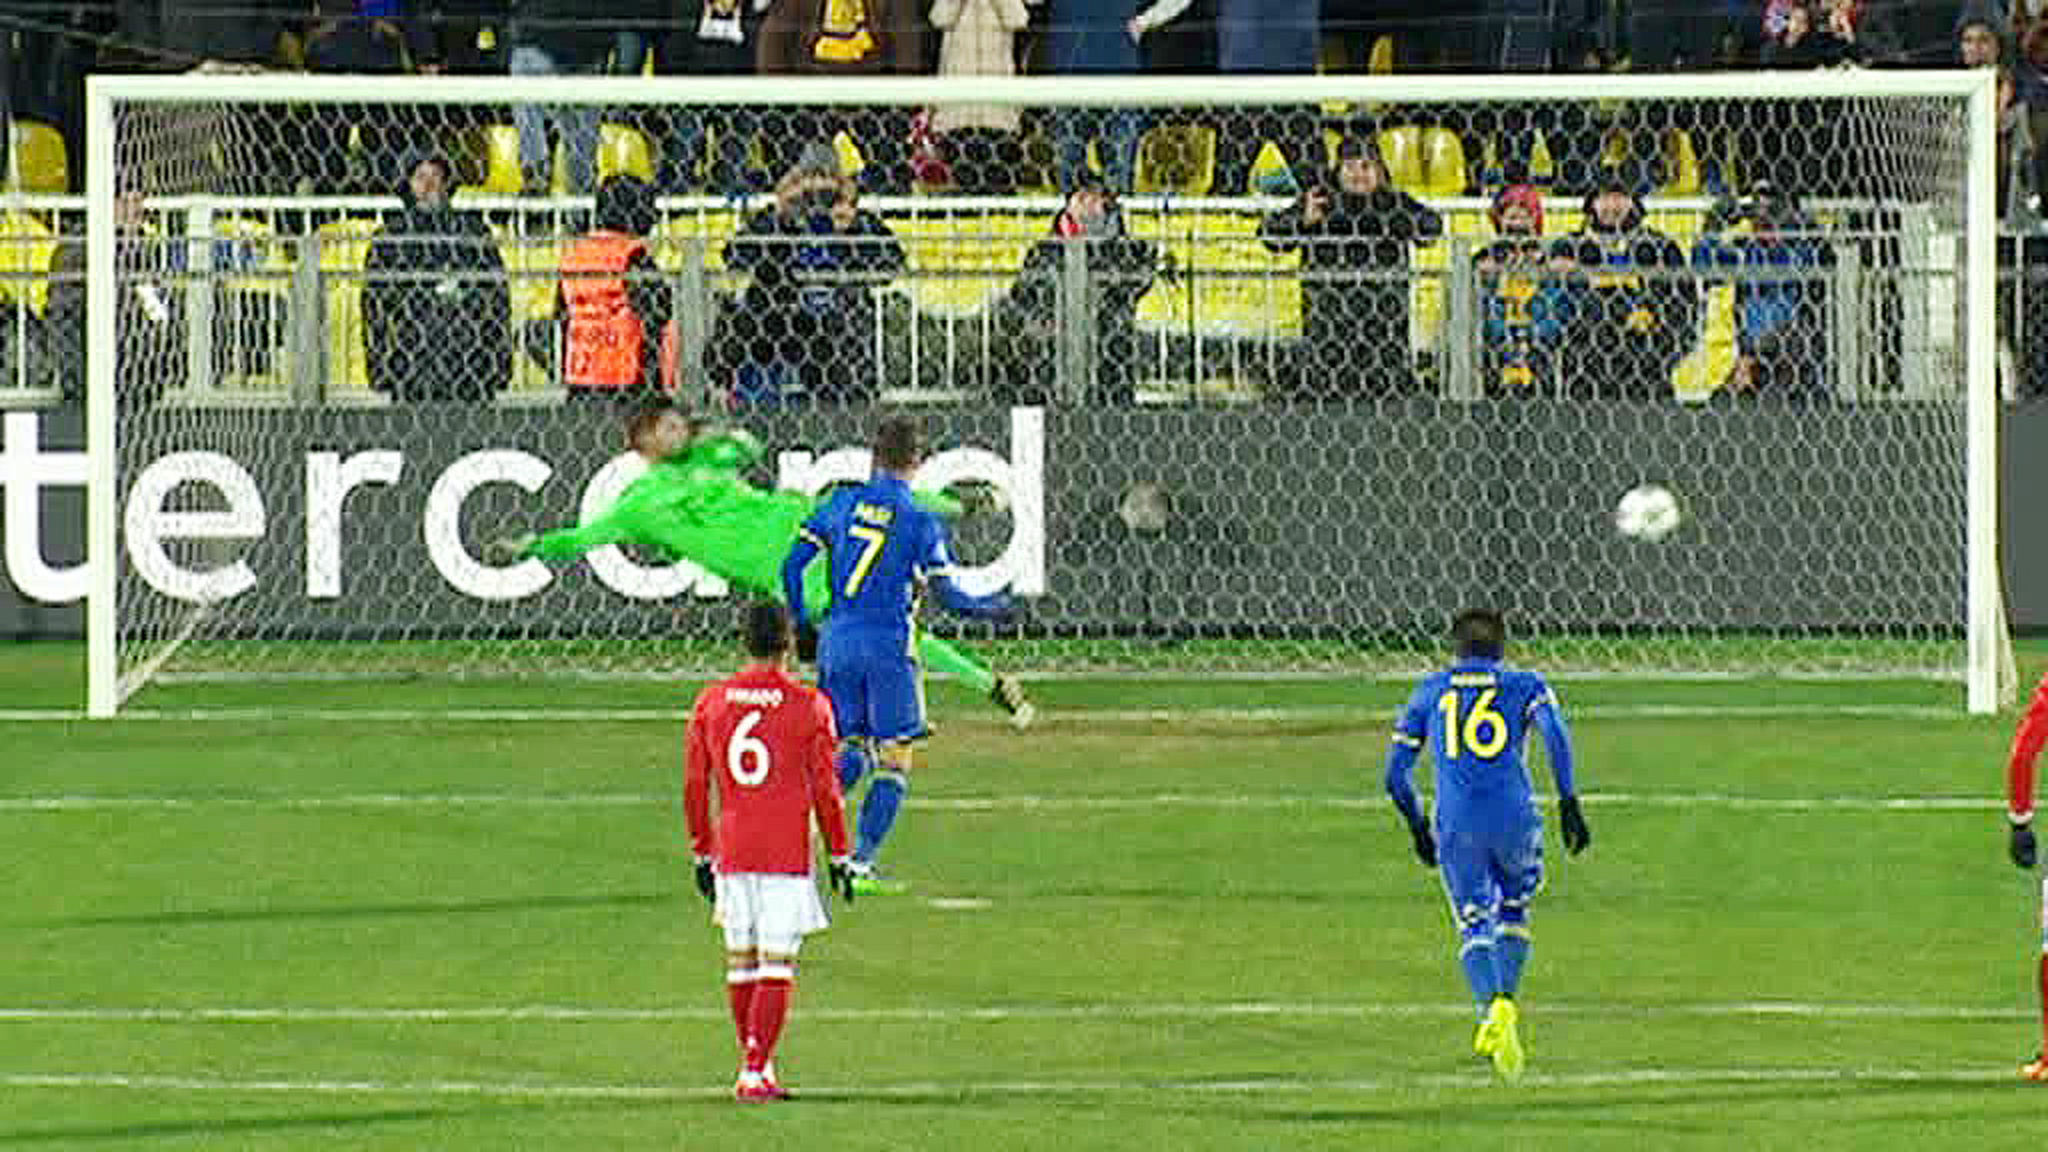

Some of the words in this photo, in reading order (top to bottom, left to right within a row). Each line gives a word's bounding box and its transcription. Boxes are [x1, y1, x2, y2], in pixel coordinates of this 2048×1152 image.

[845, 525, 885, 598] 7
[728, 710, 770, 785] 6
[1439, 688, 1507, 759] 16
